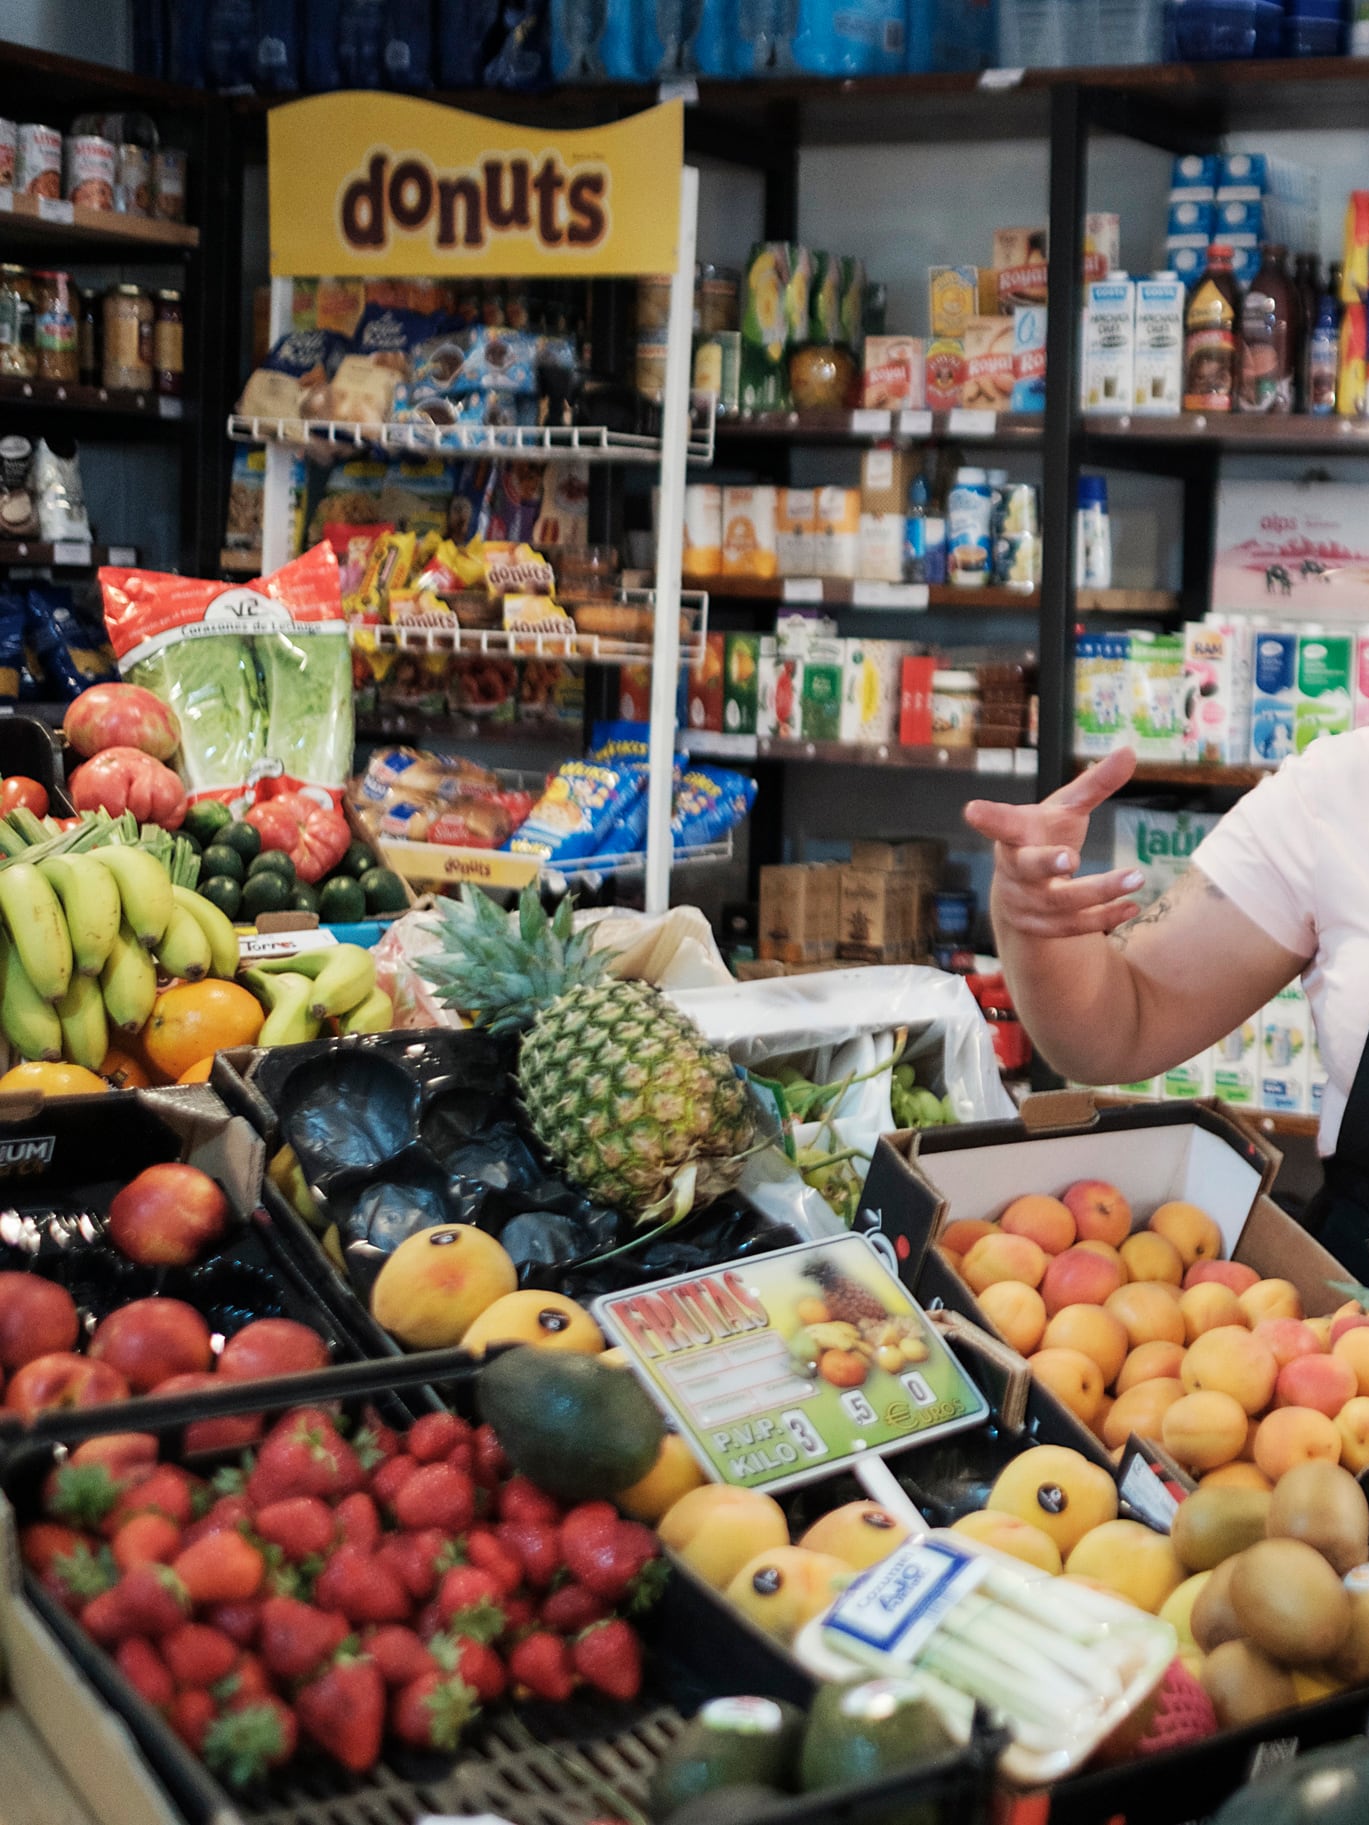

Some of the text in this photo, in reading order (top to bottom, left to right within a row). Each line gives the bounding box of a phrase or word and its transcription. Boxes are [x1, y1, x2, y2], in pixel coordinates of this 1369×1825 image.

[342, 152, 606, 247] donuts
[489, 563, 553, 585] donuts
[180, 620, 248, 637] Corazones
[252, 620, 268, 631] de
[271, 621, 321, 636] Lechuga
[444, 858, 491, 877] donuts
[611, 1270, 770, 1359] FRUTAS
[711, 1418, 784, 1453] P.V.P.
[789, 1418, 817, 1453] 3
[730, 1442, 798, 1479] KILO
